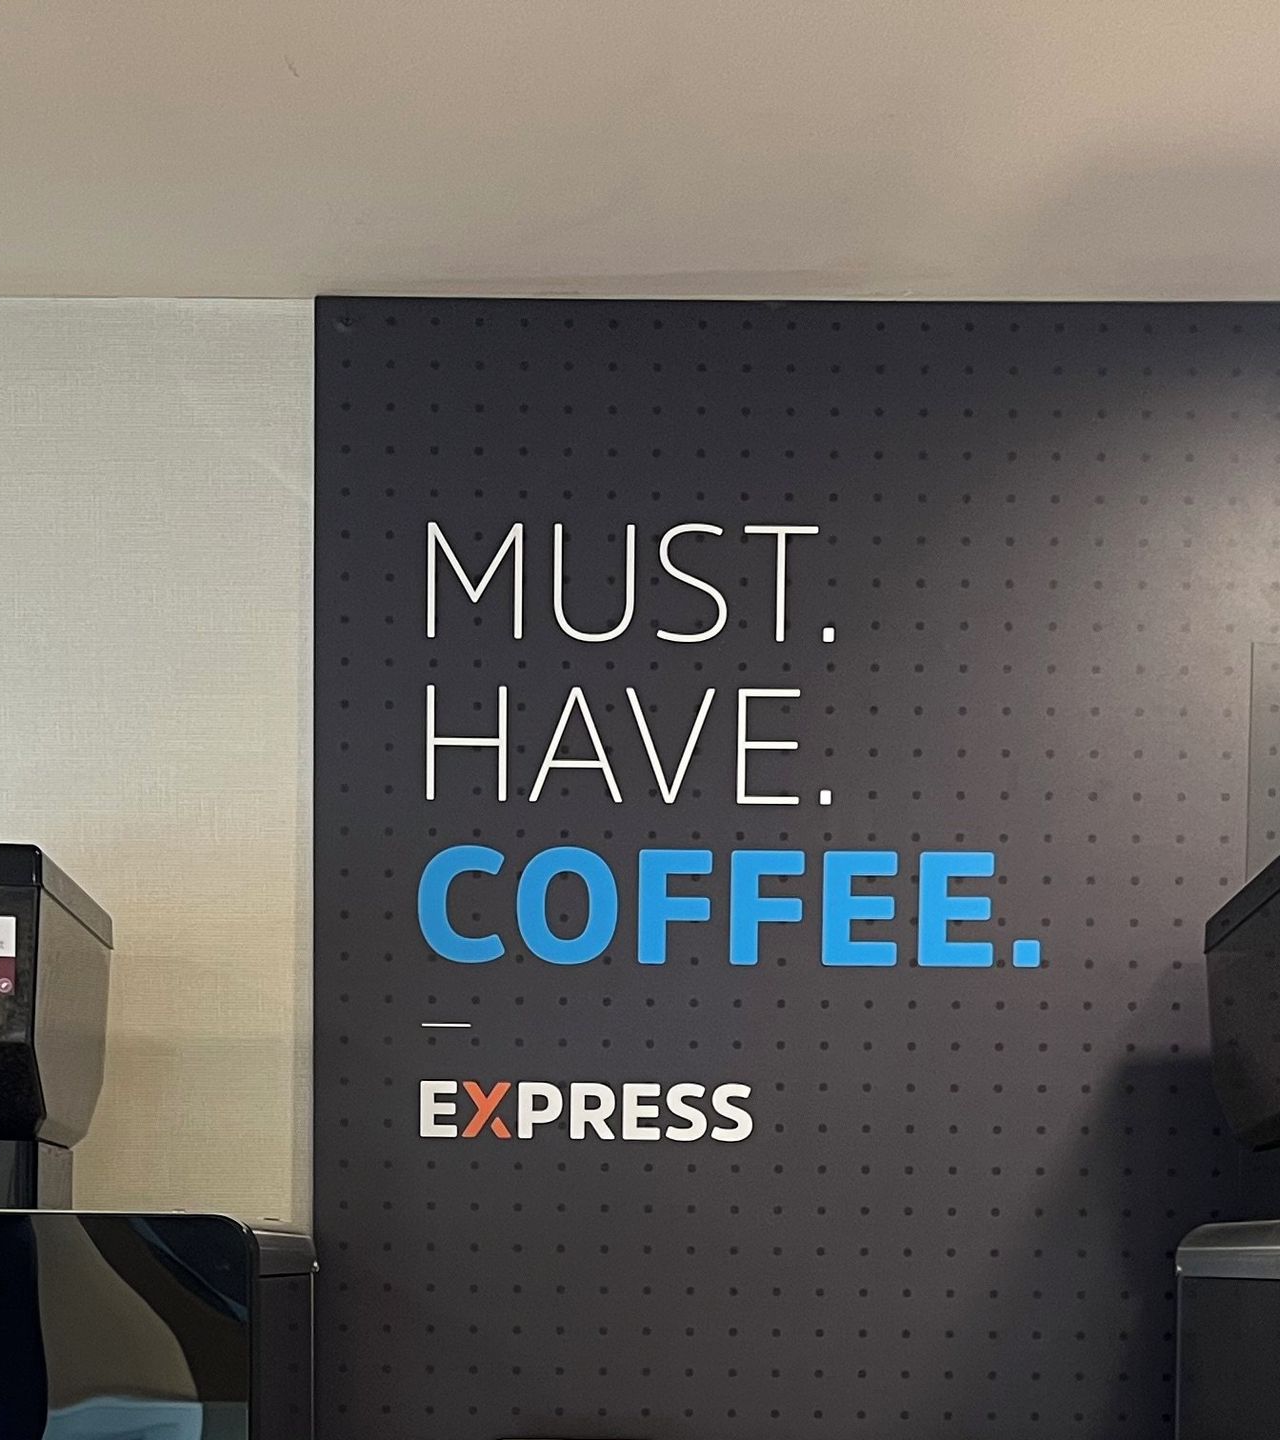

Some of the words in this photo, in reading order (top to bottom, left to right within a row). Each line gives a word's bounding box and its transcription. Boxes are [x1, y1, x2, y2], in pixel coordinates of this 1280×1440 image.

[425, 520, 836, 644] MUST.
[424, 684, 833, 806] HAVE.
[417, 843, 1041, 968] COFFEE.
[419, 1079, 755, 1142] EXPRESS
